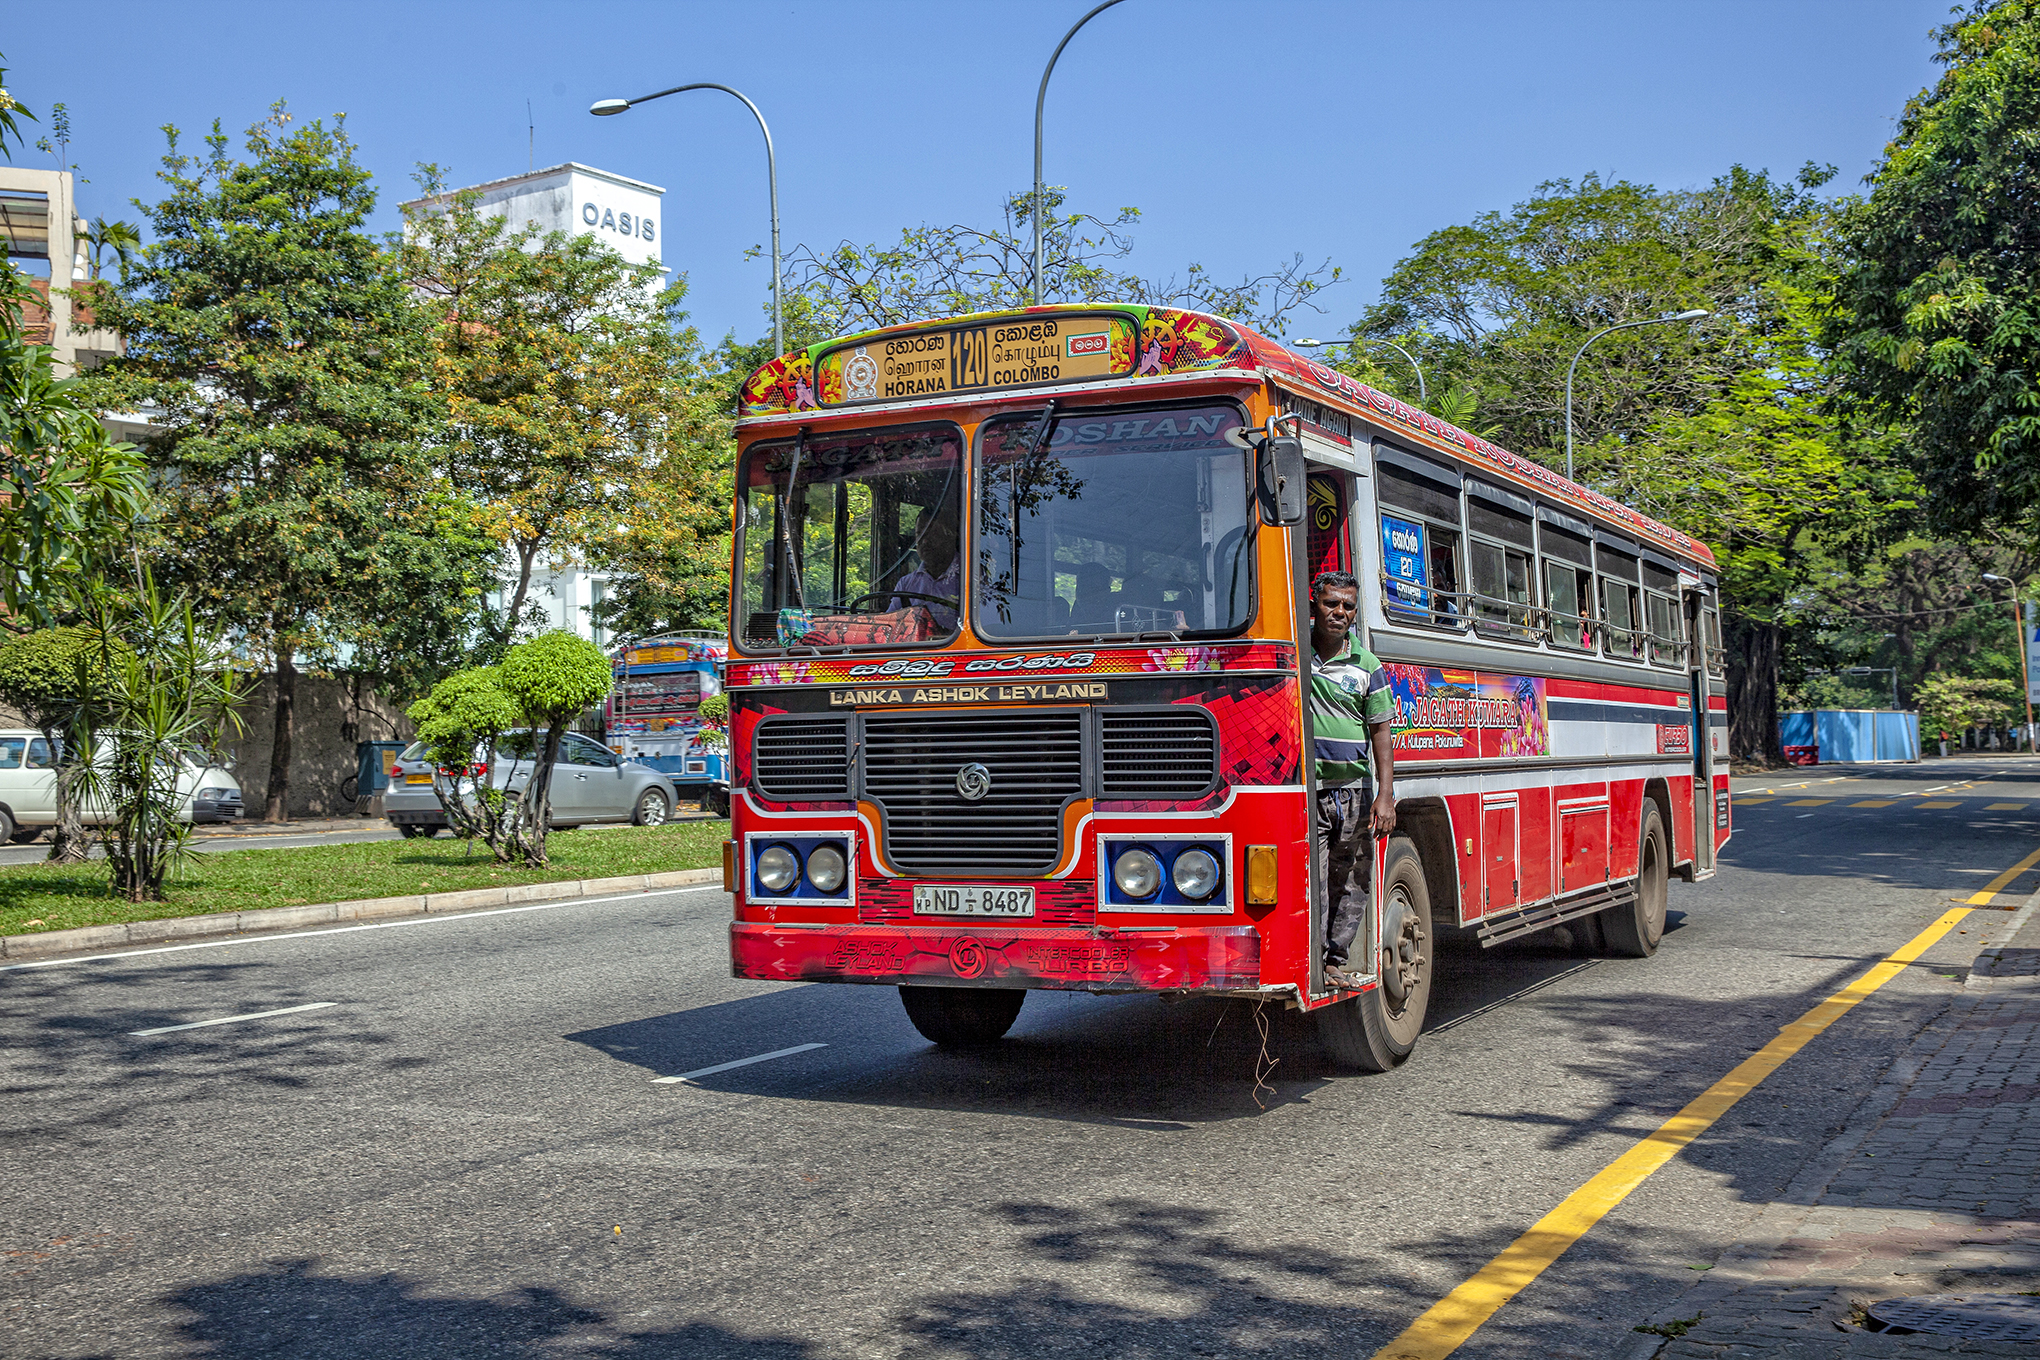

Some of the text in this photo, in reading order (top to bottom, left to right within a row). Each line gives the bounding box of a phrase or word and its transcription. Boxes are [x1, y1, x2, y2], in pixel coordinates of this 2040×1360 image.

[582, 202, 656, 242] OASIS
[995, 321, 1057, 342] කොළඹ
[886, 336, 944, 355] හොරණ
[992, 340, 1060, 367] கொழும்பு
[952, 330, 986, 387] 120
[994, 365, 1060, 385] COLOMBO
[885, 377, 946, 397] HORANA
[1308, 362, 1467, 450] JAGATH
[1329, 407, 1349, 437] AGAIN
[829, 683, 1107, 705] LANKA ASHOK LEYLAND
[1411, 695, 1466, 728] JAGATH
[1466, 697, 1518, 729] KUMARA
[833, 940, 899, 957] ASHOK
[1026, 945, 1130, 960] INTERCOOLER
[825, 953, 906, 971] LEYLAND
[1028, 958, 1129, 974] TURBO
